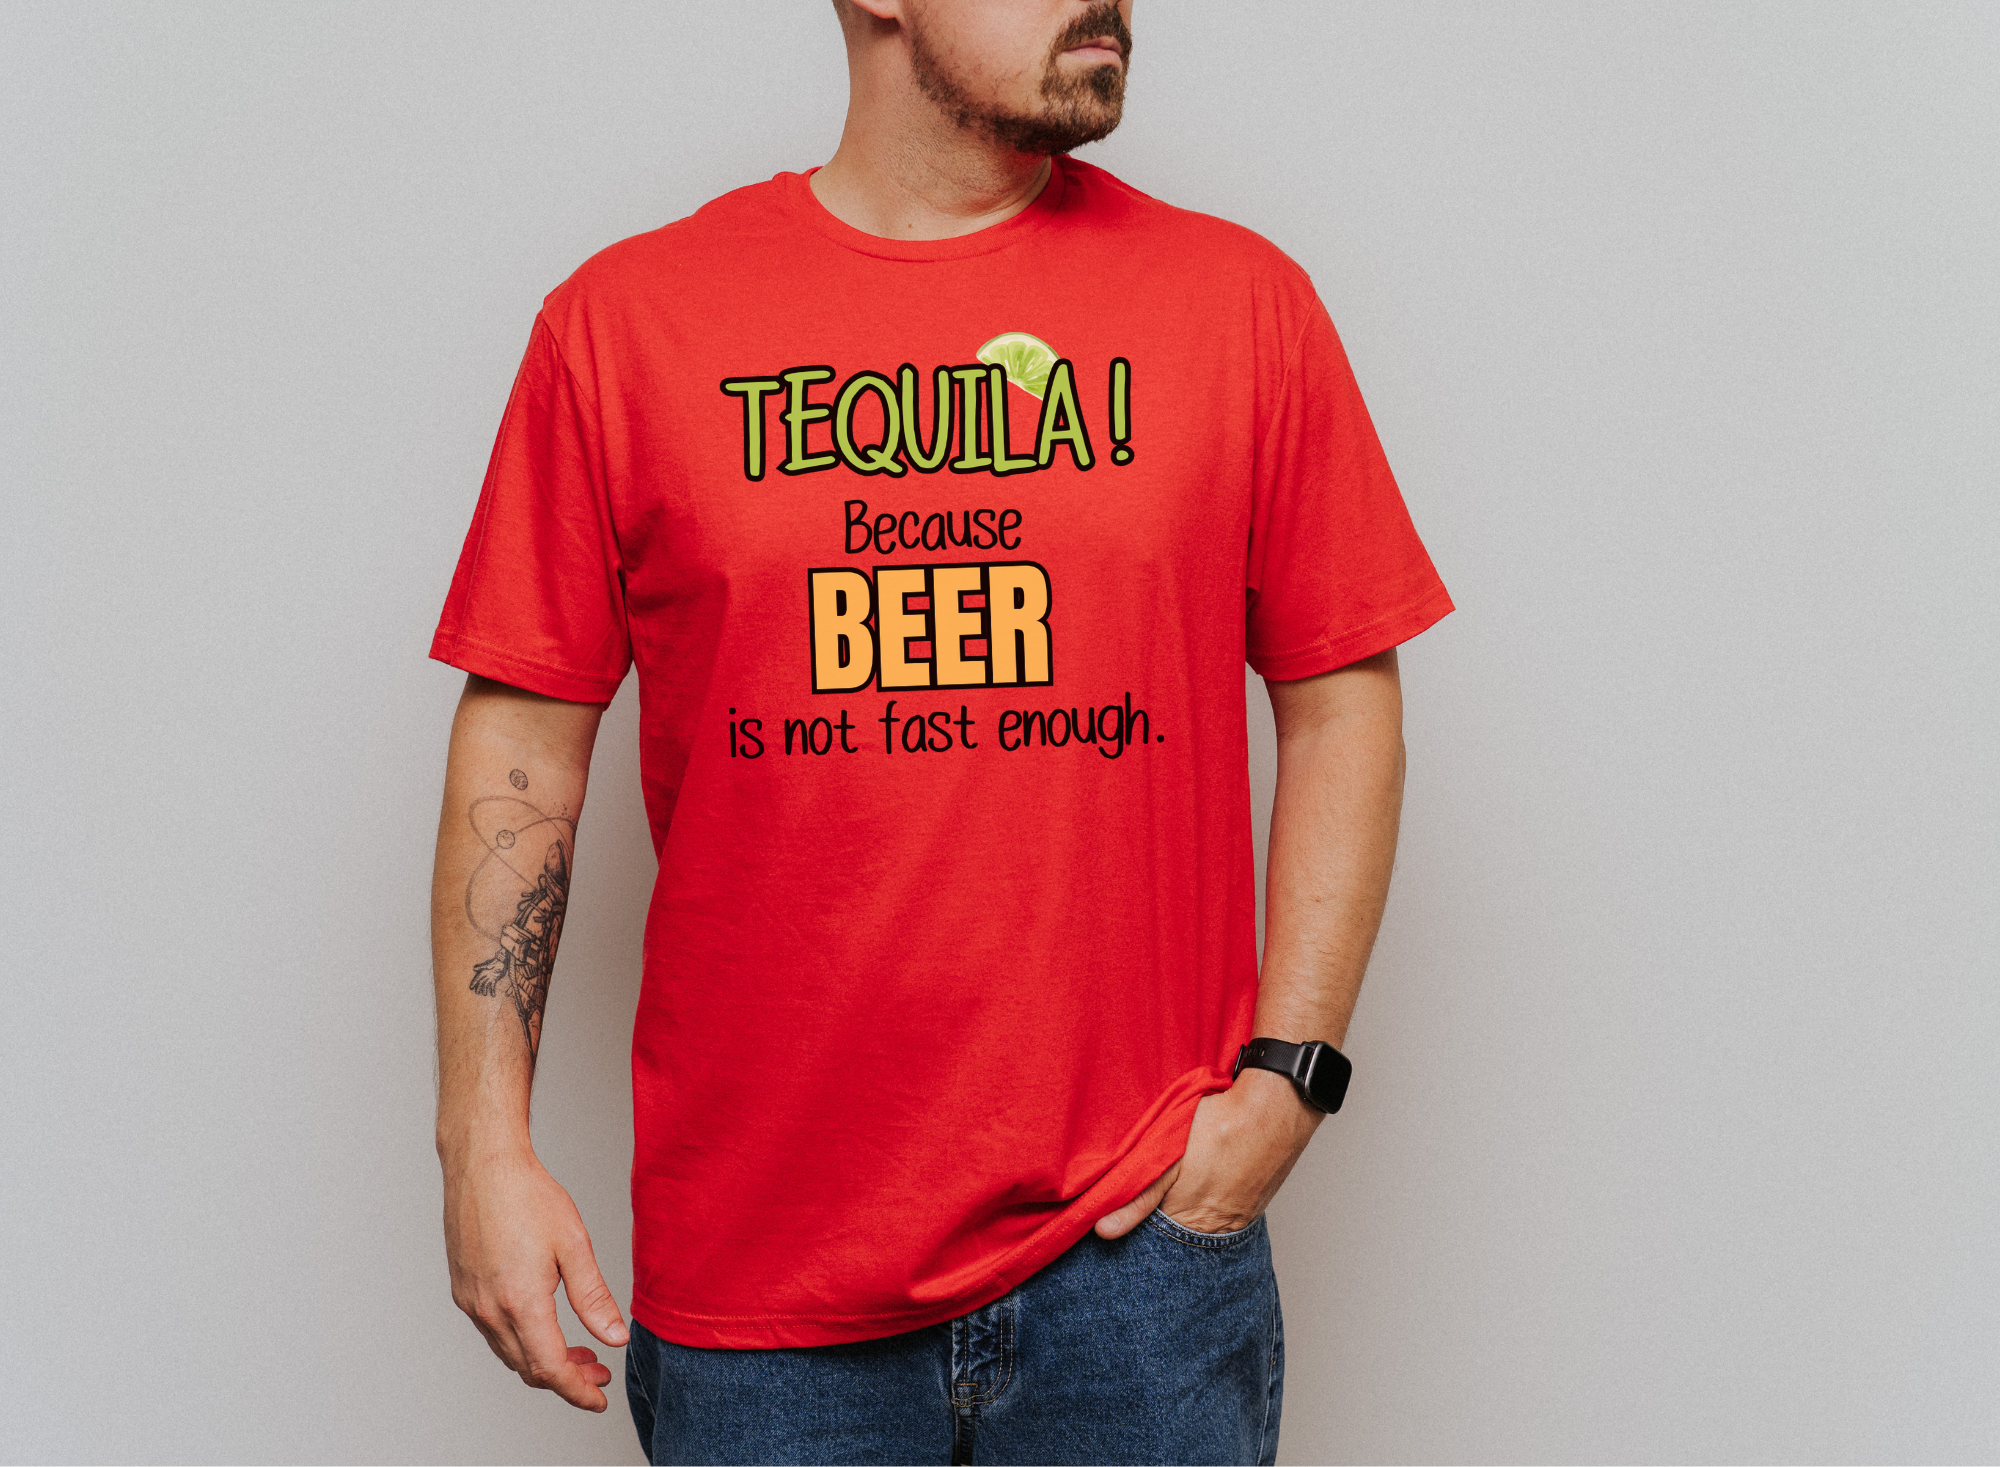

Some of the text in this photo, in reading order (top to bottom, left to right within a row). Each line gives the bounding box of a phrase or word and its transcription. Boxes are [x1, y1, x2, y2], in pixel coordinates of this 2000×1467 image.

[844, 499, 1023, 555] Because
[807, 560, 1054, 695] BEER
[728, 691, 1165, 760] is not fast enough.
